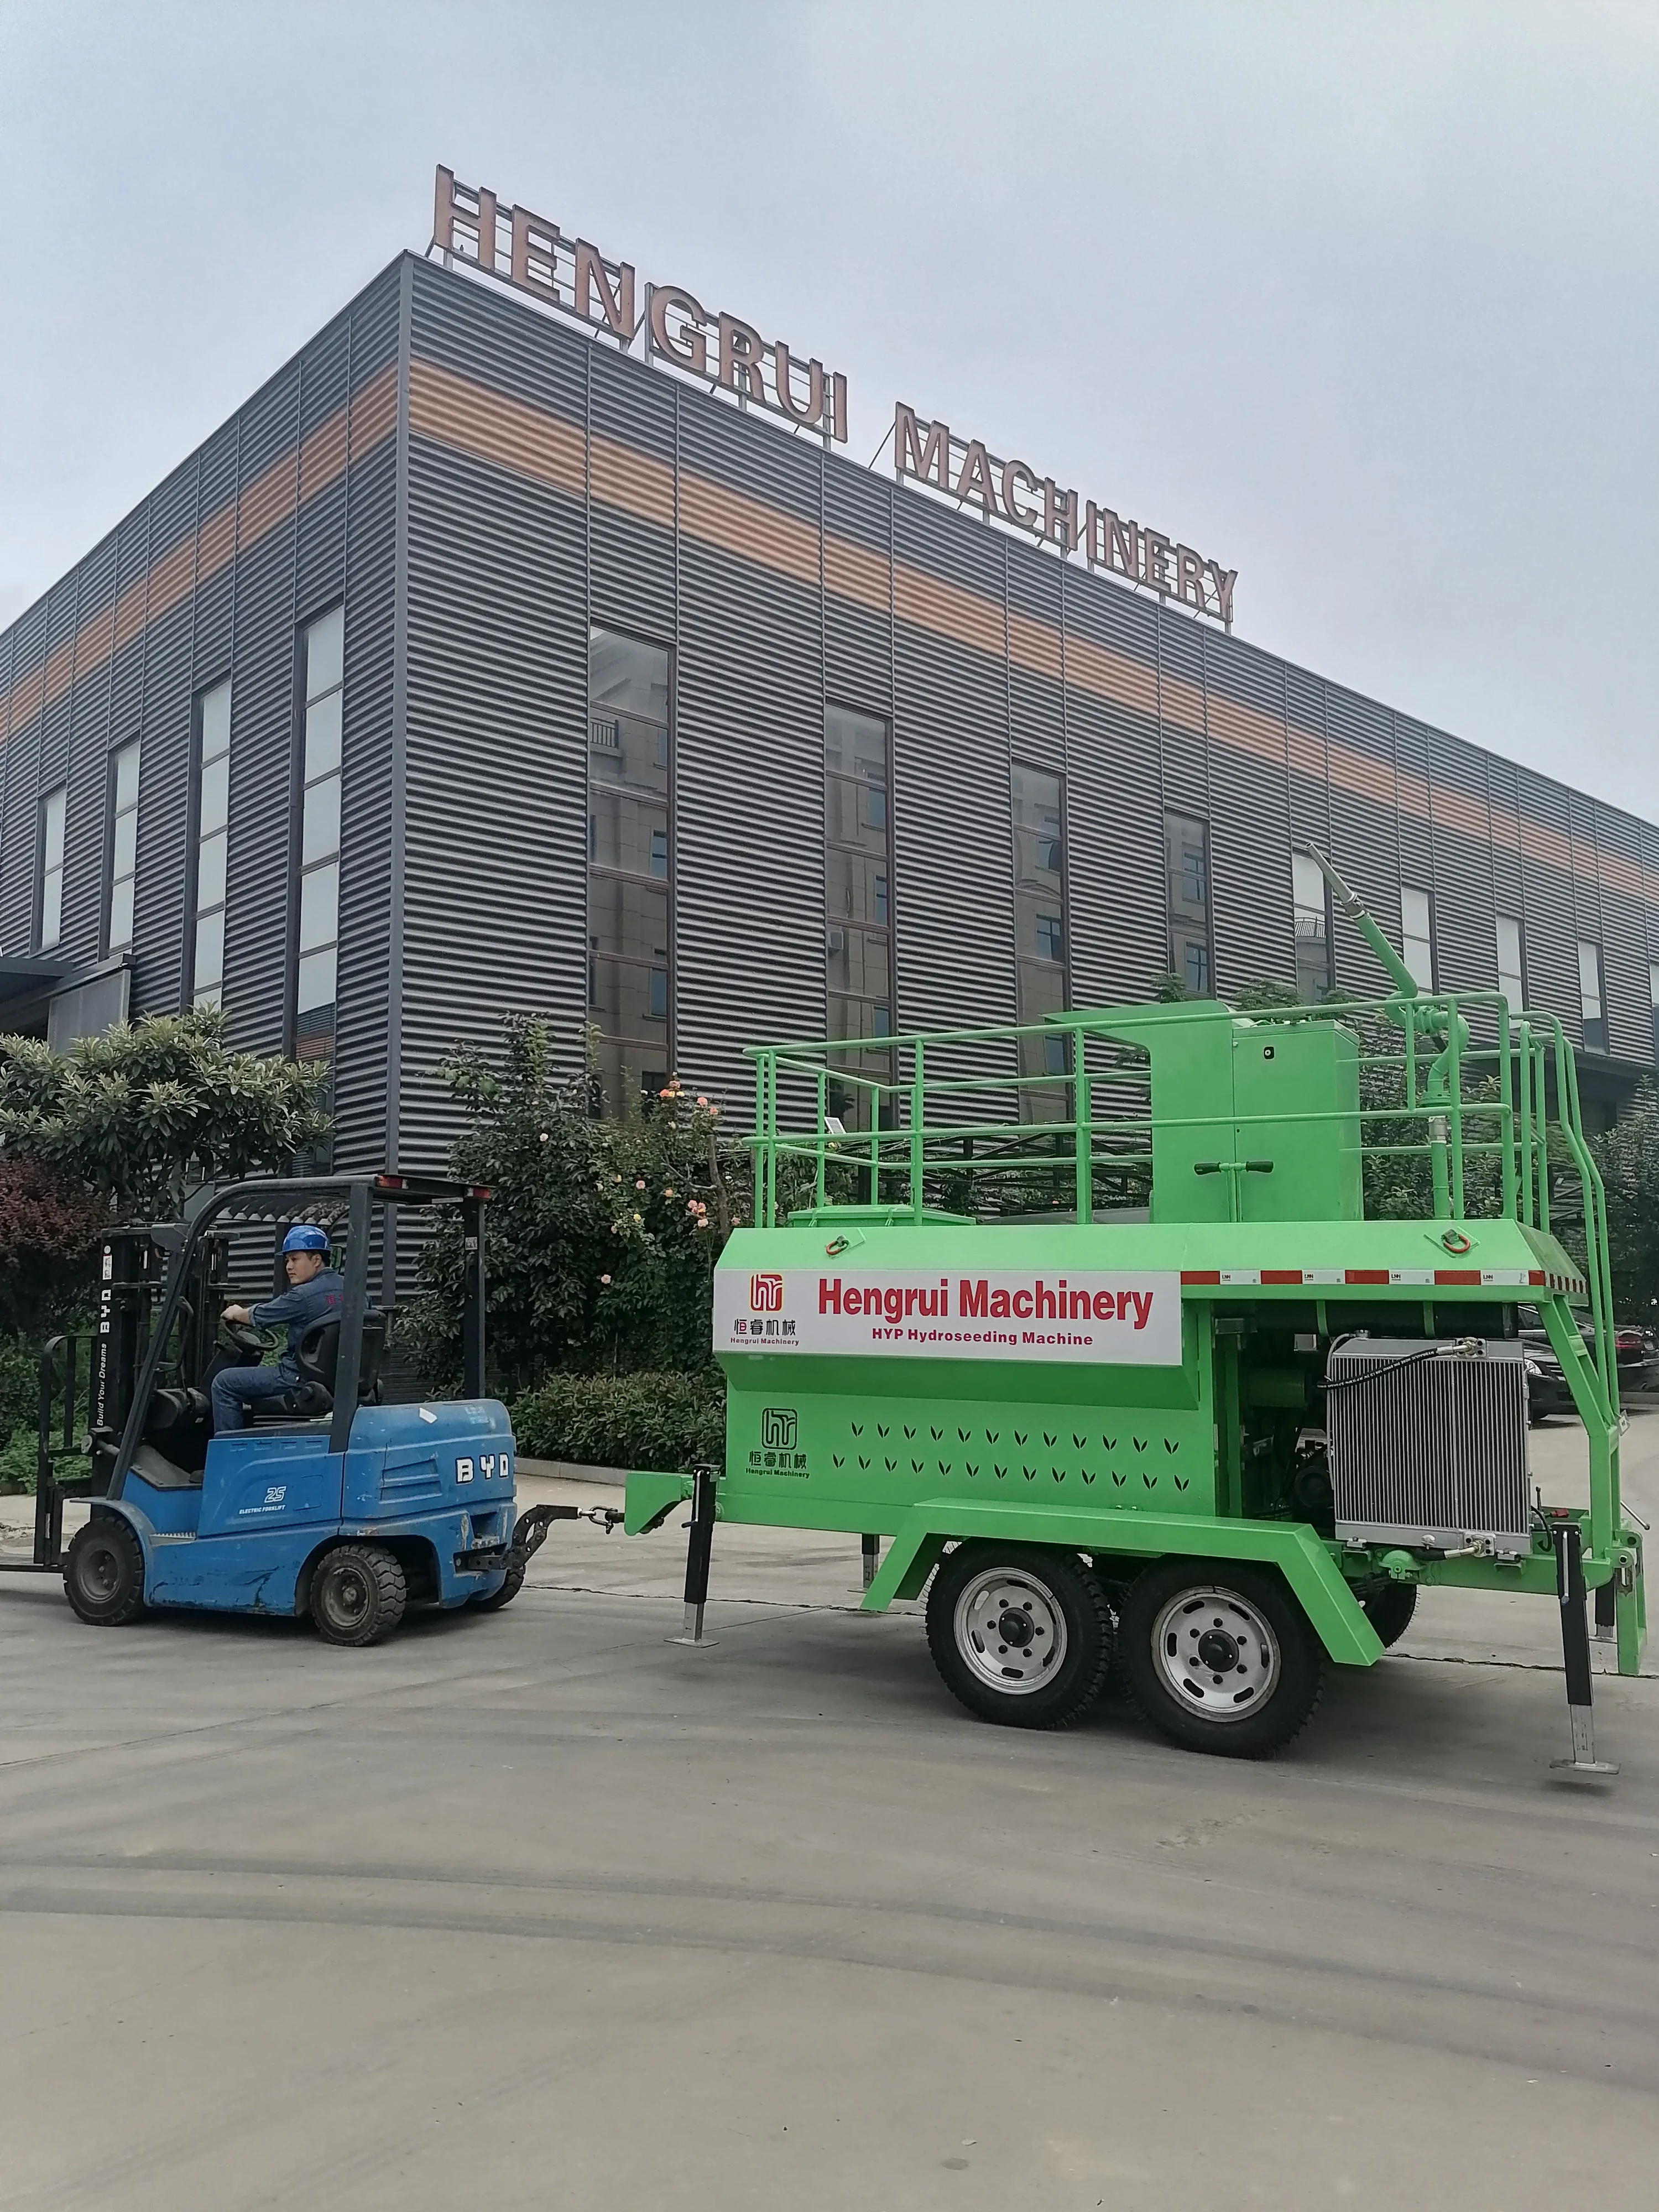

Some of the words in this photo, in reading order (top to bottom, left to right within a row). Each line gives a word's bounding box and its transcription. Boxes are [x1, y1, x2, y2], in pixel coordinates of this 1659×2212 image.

[435, 164, 848, 443] HENGRUI
[895, 401, 1238, 624] MACHINERY
[100, 1289, 111, 1333] BYD
[819, 1278, 948, 1323] Hengrui
[960, 1279, 1153, 1329] Machinery
[734, 1318, 796, 1336] 恒睿机械
[760, 1338, 800, 1347] Machinery
[872, 1328, 904, 1340] HYP
[908, 1329, 1017, 1345] Hydroseeding
[1022, 1332, 1093, 1345] Machine
[457, 1453, 509, 1483] BYD
[749, 1451, 807, 1469] 恒睿机械
[745, 1467, 773, 1476] Hengrui
[774, 1469, 810, 1479] Machinery
[264, 1485, 287, 1503] 25
[262, 1504, 286, 1512] FORKLIFT
